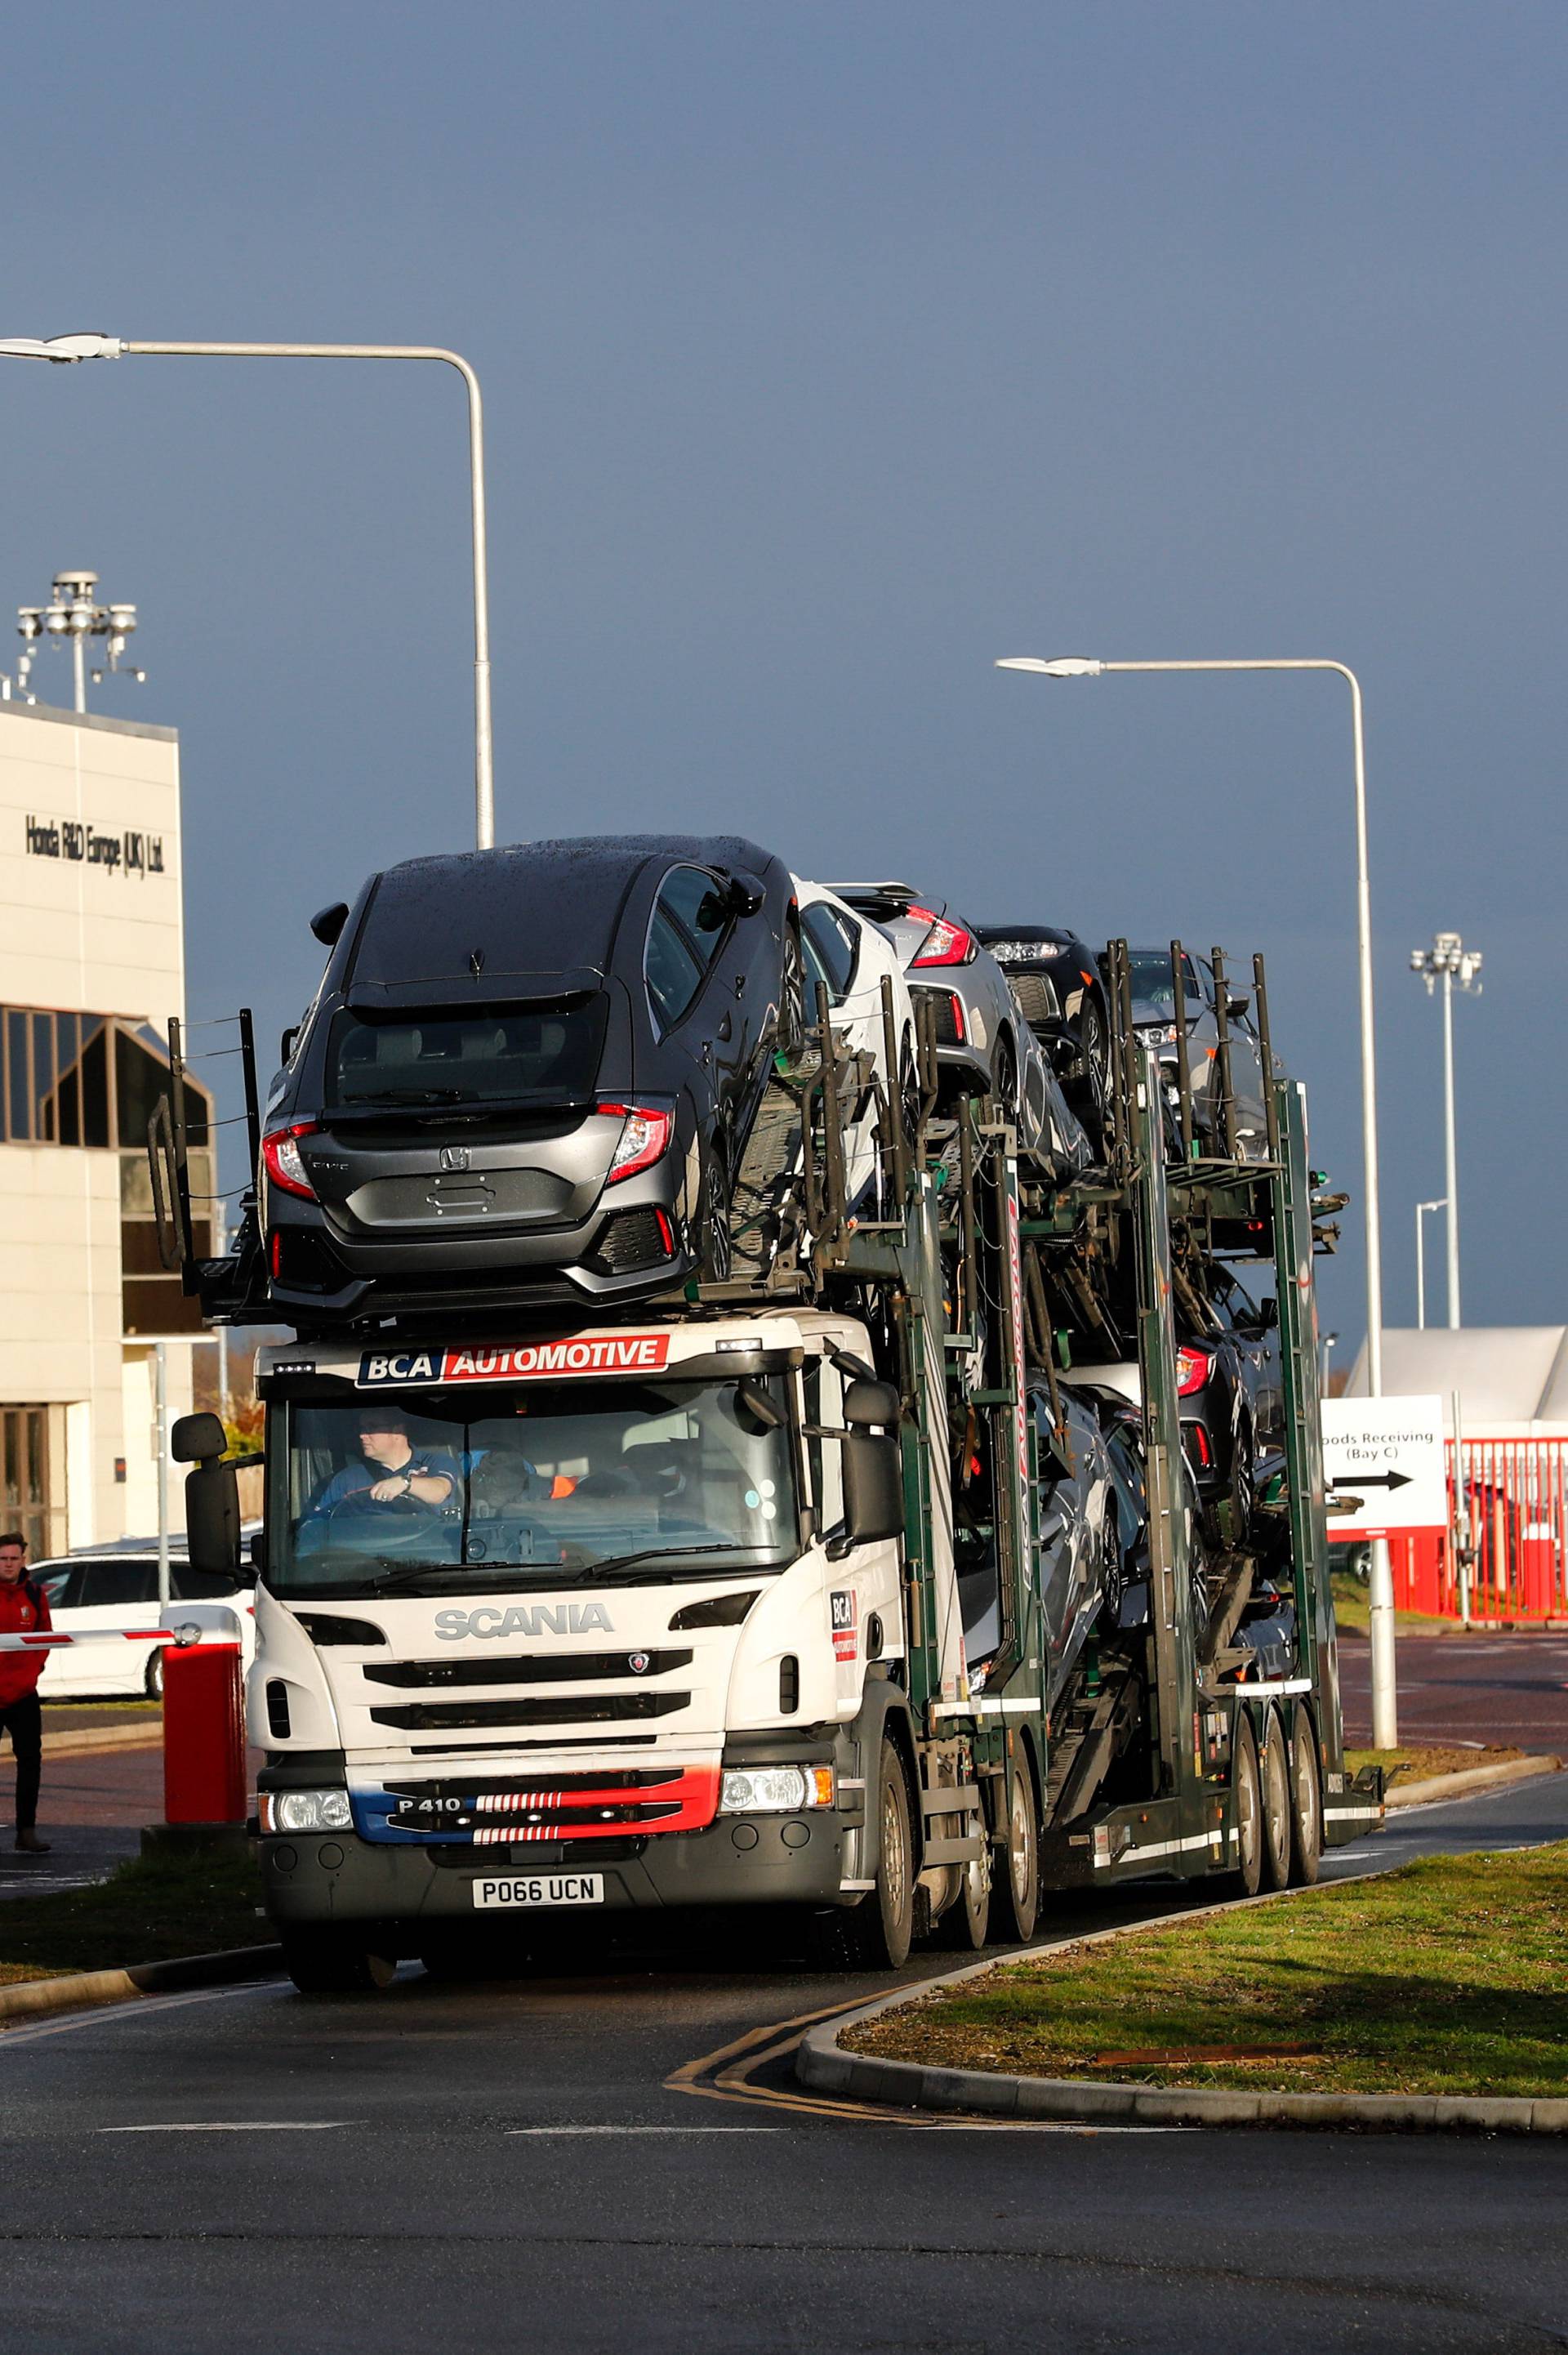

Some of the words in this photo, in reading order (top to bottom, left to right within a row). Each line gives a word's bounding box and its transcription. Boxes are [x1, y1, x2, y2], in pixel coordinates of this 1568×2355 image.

[26, 814, 59, 857] Honda
[62, 822, 83, 860] R&D
[87, 826, 120, 876] Europe
[368, 1353, 433, 1380] BCA
[451, 1340, 658, 1376] AUTOMOTIVE
[1321, 1433, 1357, 1446] oods
[1362, 1431, 1434, 1444] Receiving
[1346, 1447, 1379, 1461] (Bay
[1383, 1447, 1399, 1459] C)
[434, 1603, 616, 1641] SCANIA
[833, 1596, 851, 1624] BCA
[399, 1800, 413, 1813] P
[418, 1798, 461, 1812] 410
[550, 1878, 595, 1901] UCN
